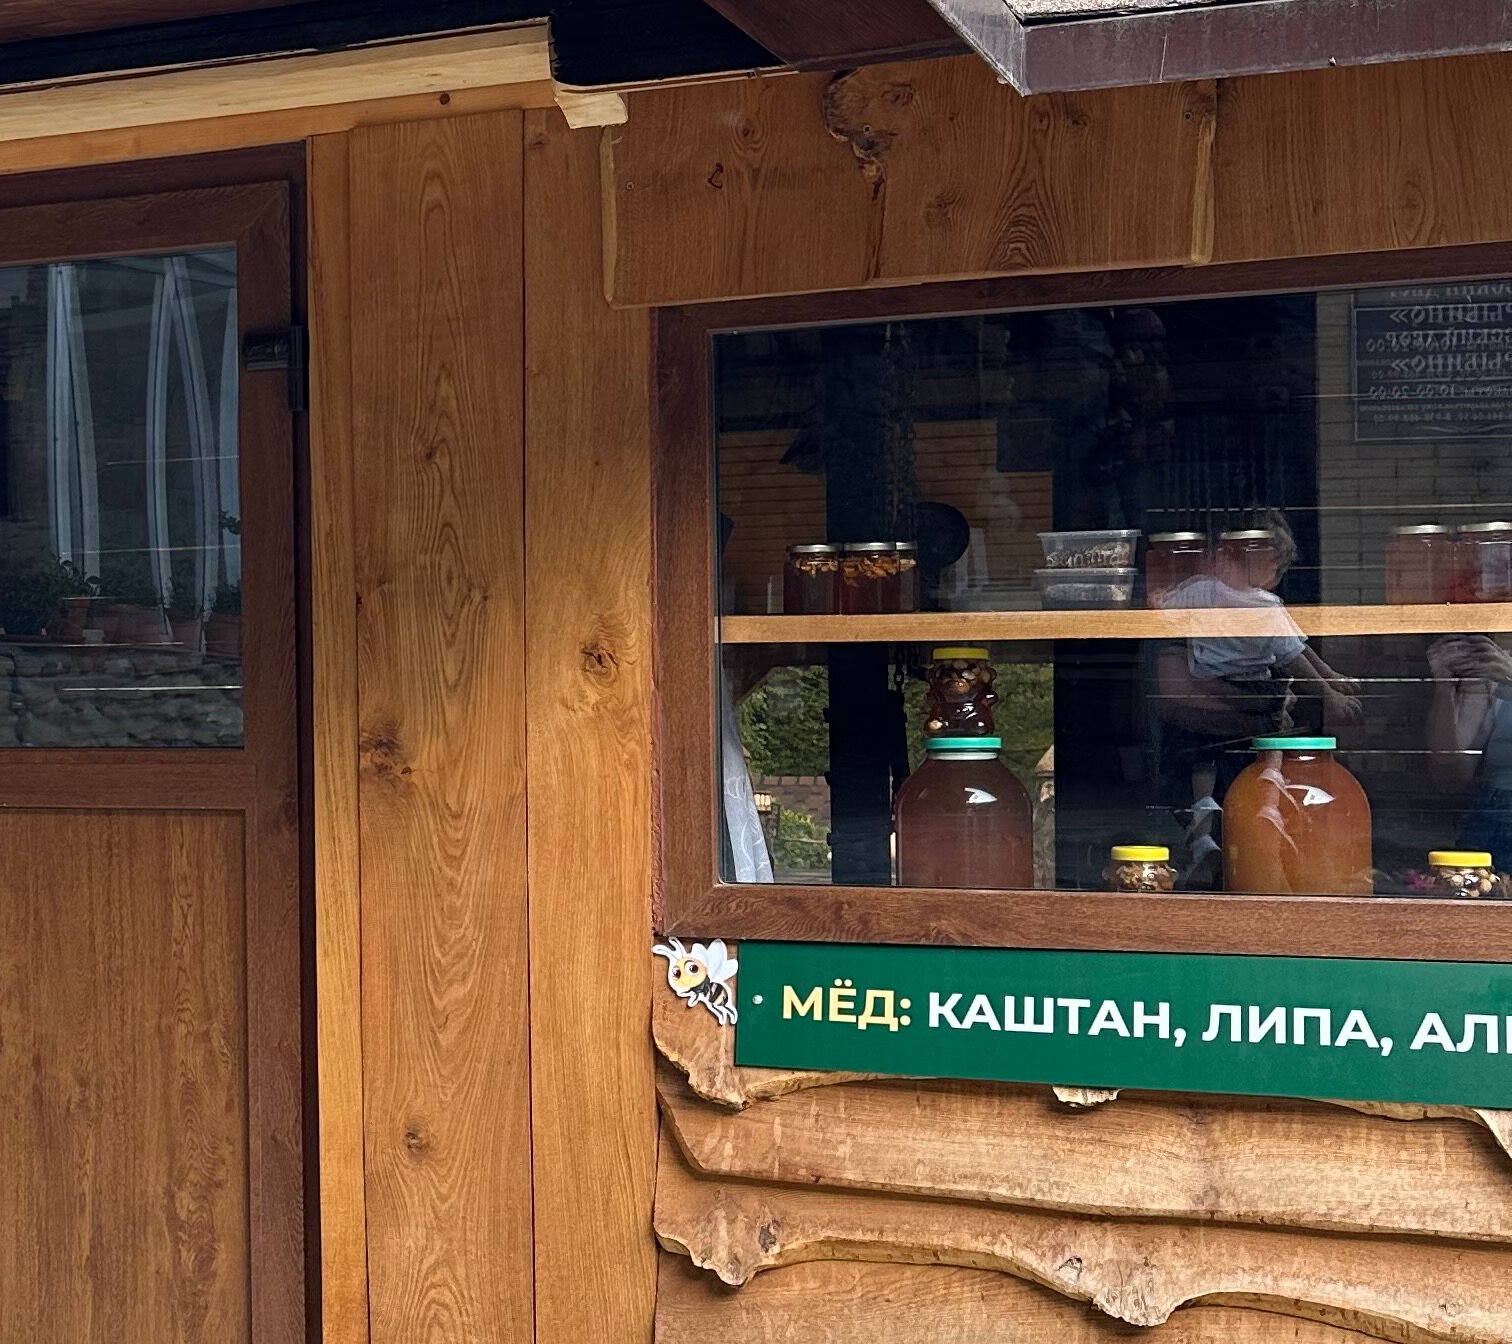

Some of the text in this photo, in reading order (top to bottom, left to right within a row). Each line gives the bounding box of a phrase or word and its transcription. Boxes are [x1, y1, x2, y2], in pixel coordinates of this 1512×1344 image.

[782, 978, 912, 1032] МЁД:
[928, 991, 1187, 1047] КАШТАН,
[1201, 1004, 1394, 1057] ЛИПА,
